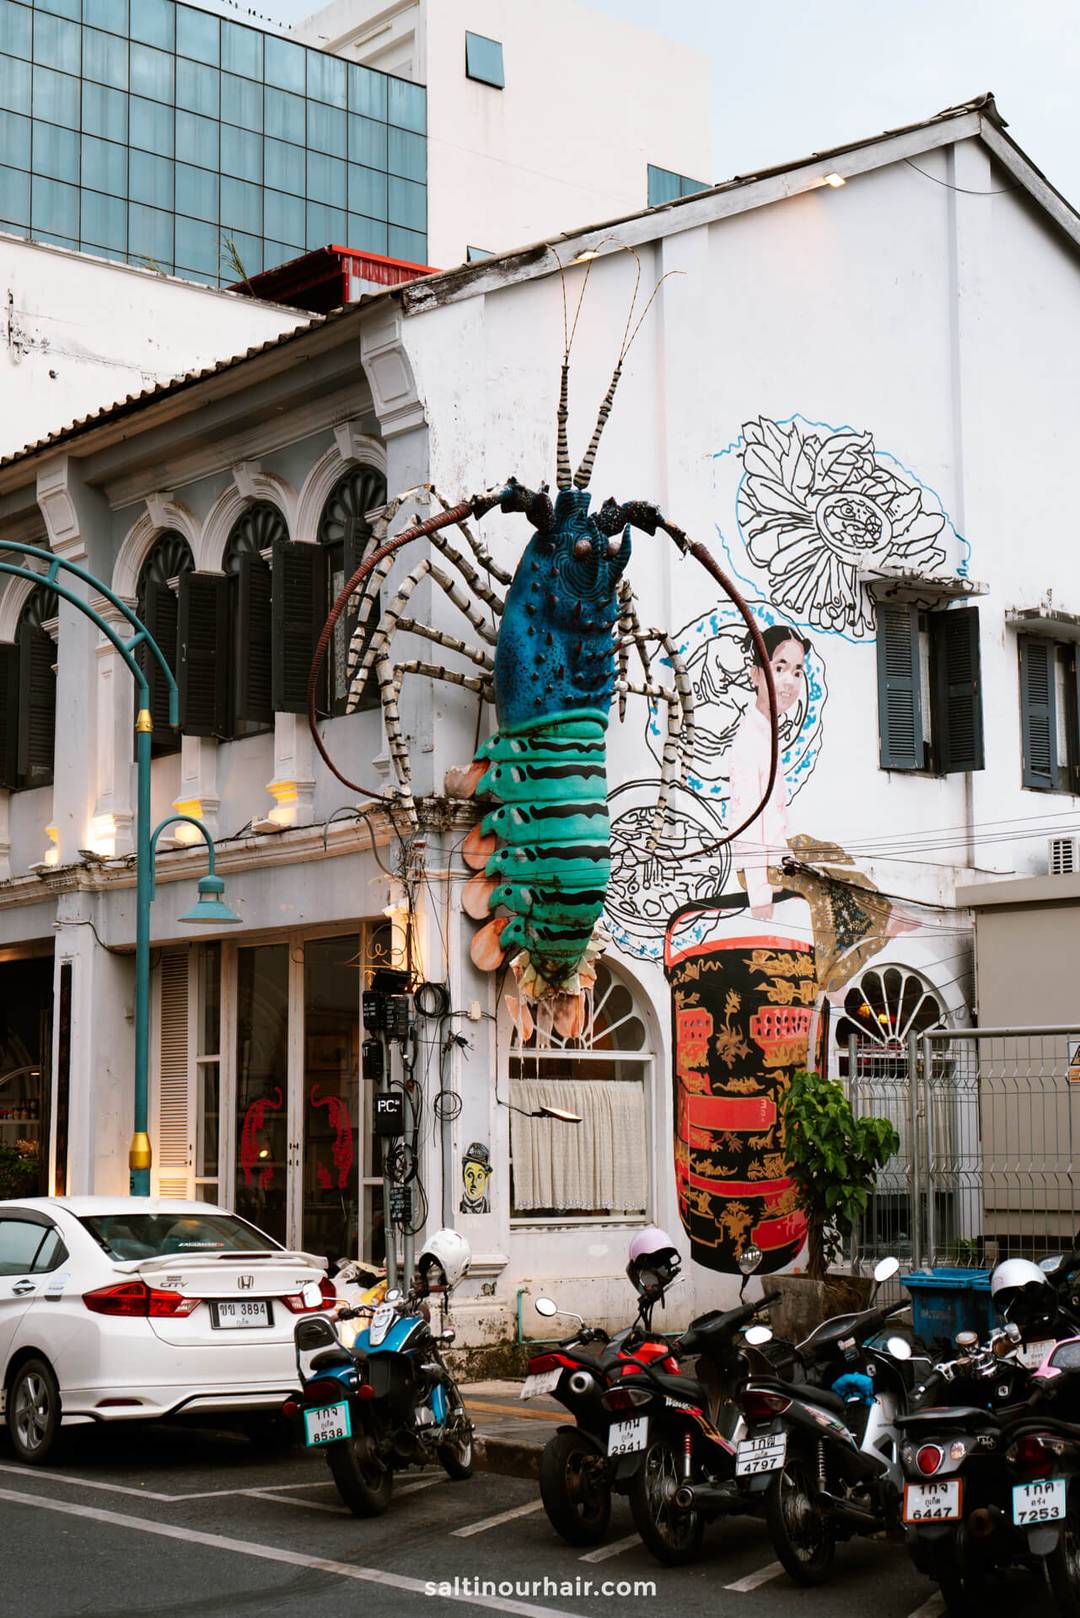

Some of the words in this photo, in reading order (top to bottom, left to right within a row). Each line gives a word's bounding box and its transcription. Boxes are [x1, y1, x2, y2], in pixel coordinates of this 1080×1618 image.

[241, 1303, 266, 1315] 3894
[313, 1428, 343, 1443] 8538
[611, 1440, 641, 1456] 2941
[744, 1458, 777, 1472] 4797
[913, 1507, 952, 1520] 6447
[1018, 1507, 1060, 1524] 7253
